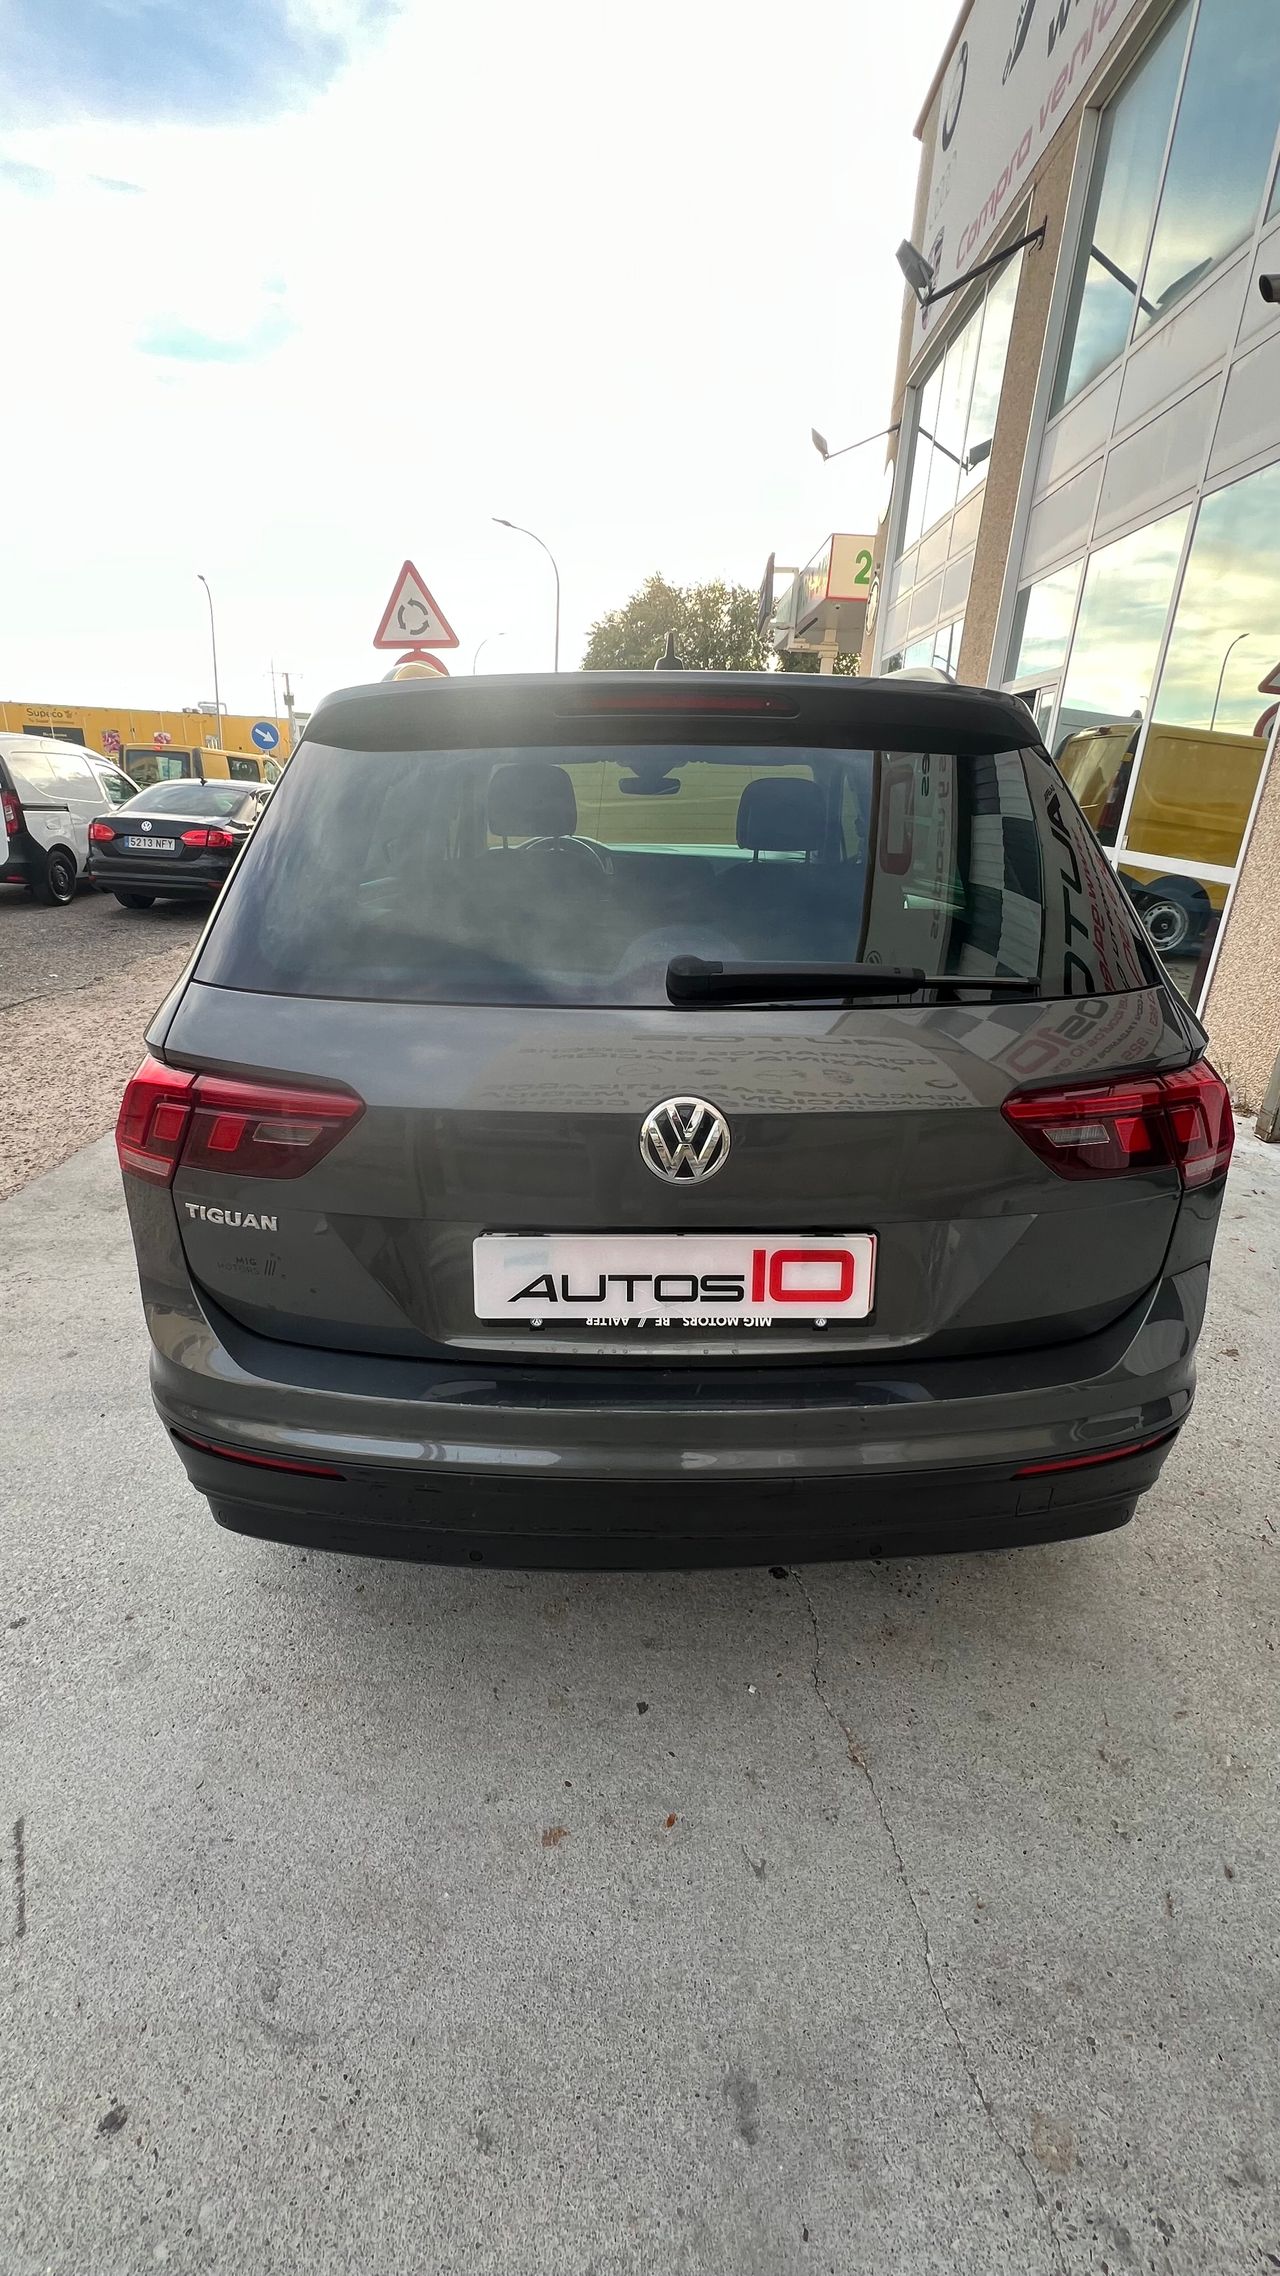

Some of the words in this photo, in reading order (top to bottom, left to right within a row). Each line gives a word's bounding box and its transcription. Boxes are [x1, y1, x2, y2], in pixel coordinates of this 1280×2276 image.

[956, 126, 1032, 269] Compra
[130, 837, 153, 848] 5213
[155, 839, 173, 849] NFY
[185, 1202, 278, 1231] TIGUAN
